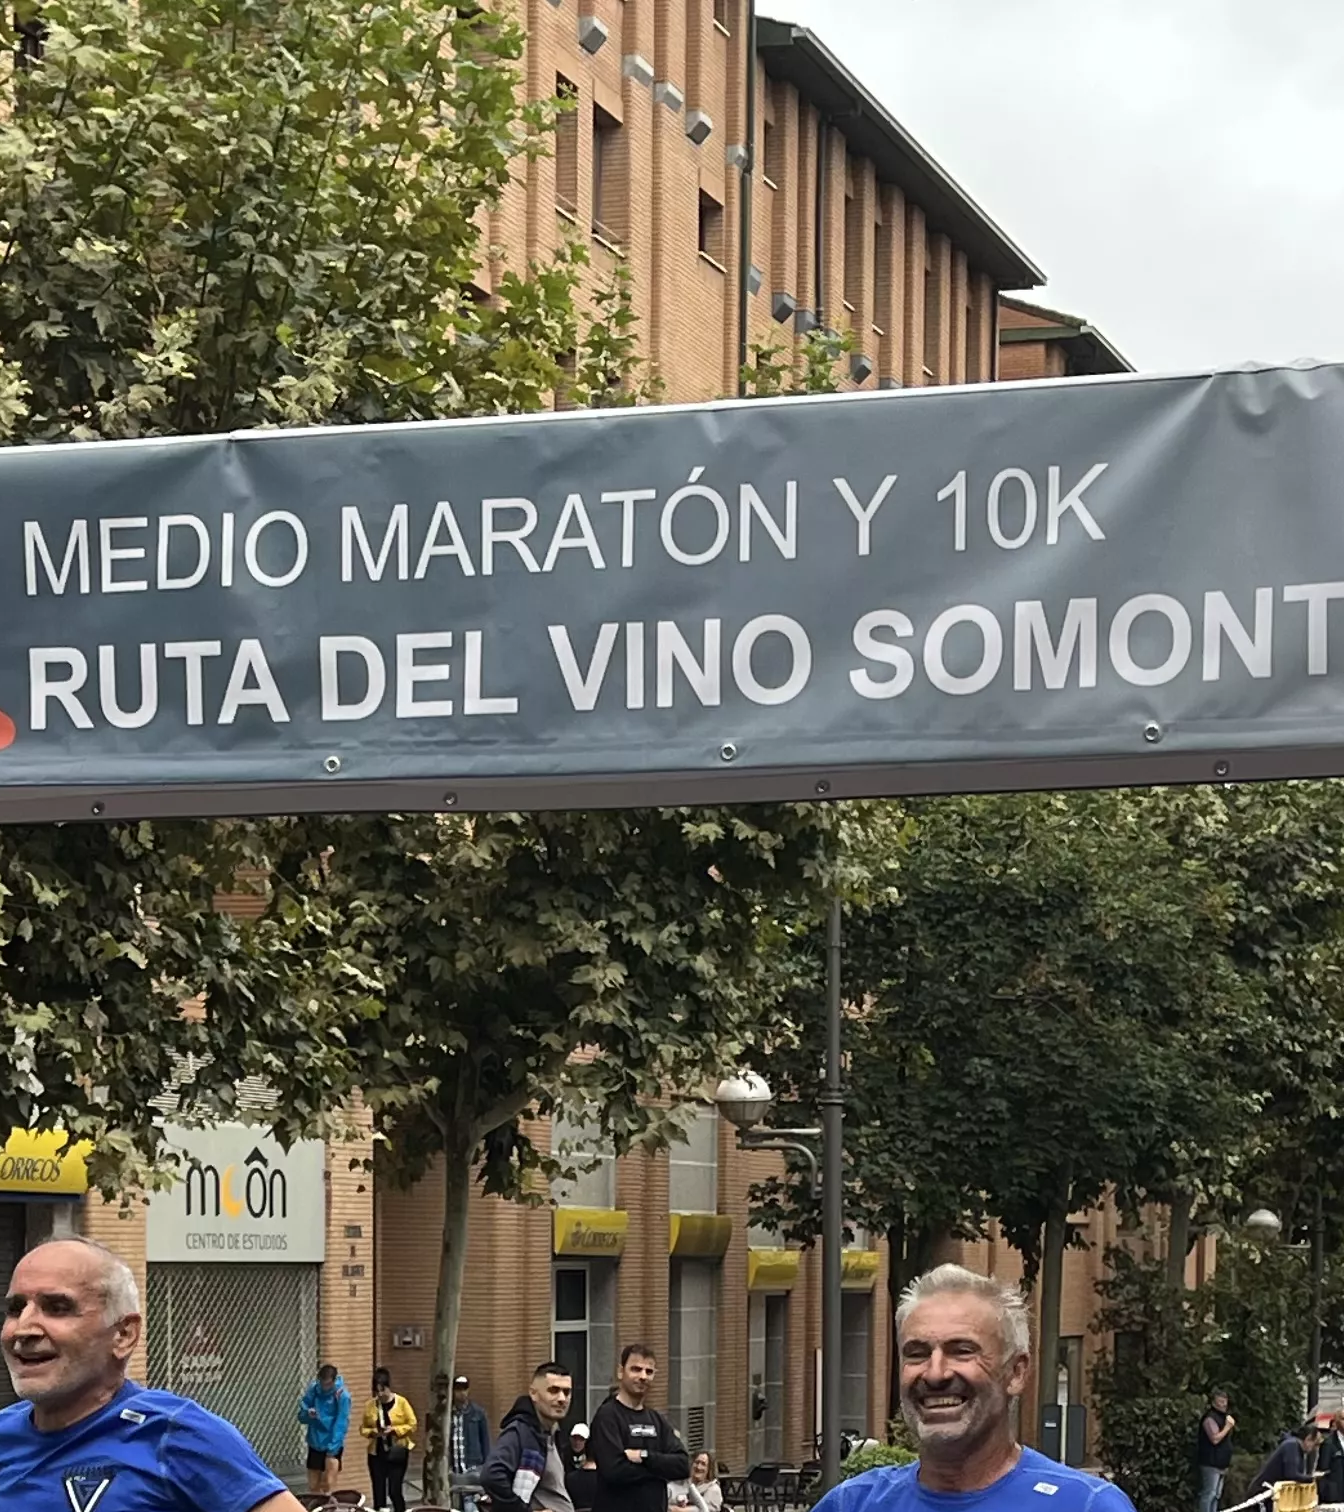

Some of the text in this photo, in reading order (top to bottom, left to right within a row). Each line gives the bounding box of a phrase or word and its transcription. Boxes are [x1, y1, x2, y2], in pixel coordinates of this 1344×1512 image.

[23, 462, 1111, 597] MEDIO MARATÓN Y 10K
[28, 638, 290, 732] RUTA
[318, 629, 520, 724] DEL
[545, 612, 813, 711] VINO
[185, 1232, 288, 1251] CENTRO DE ESTUDIOS
